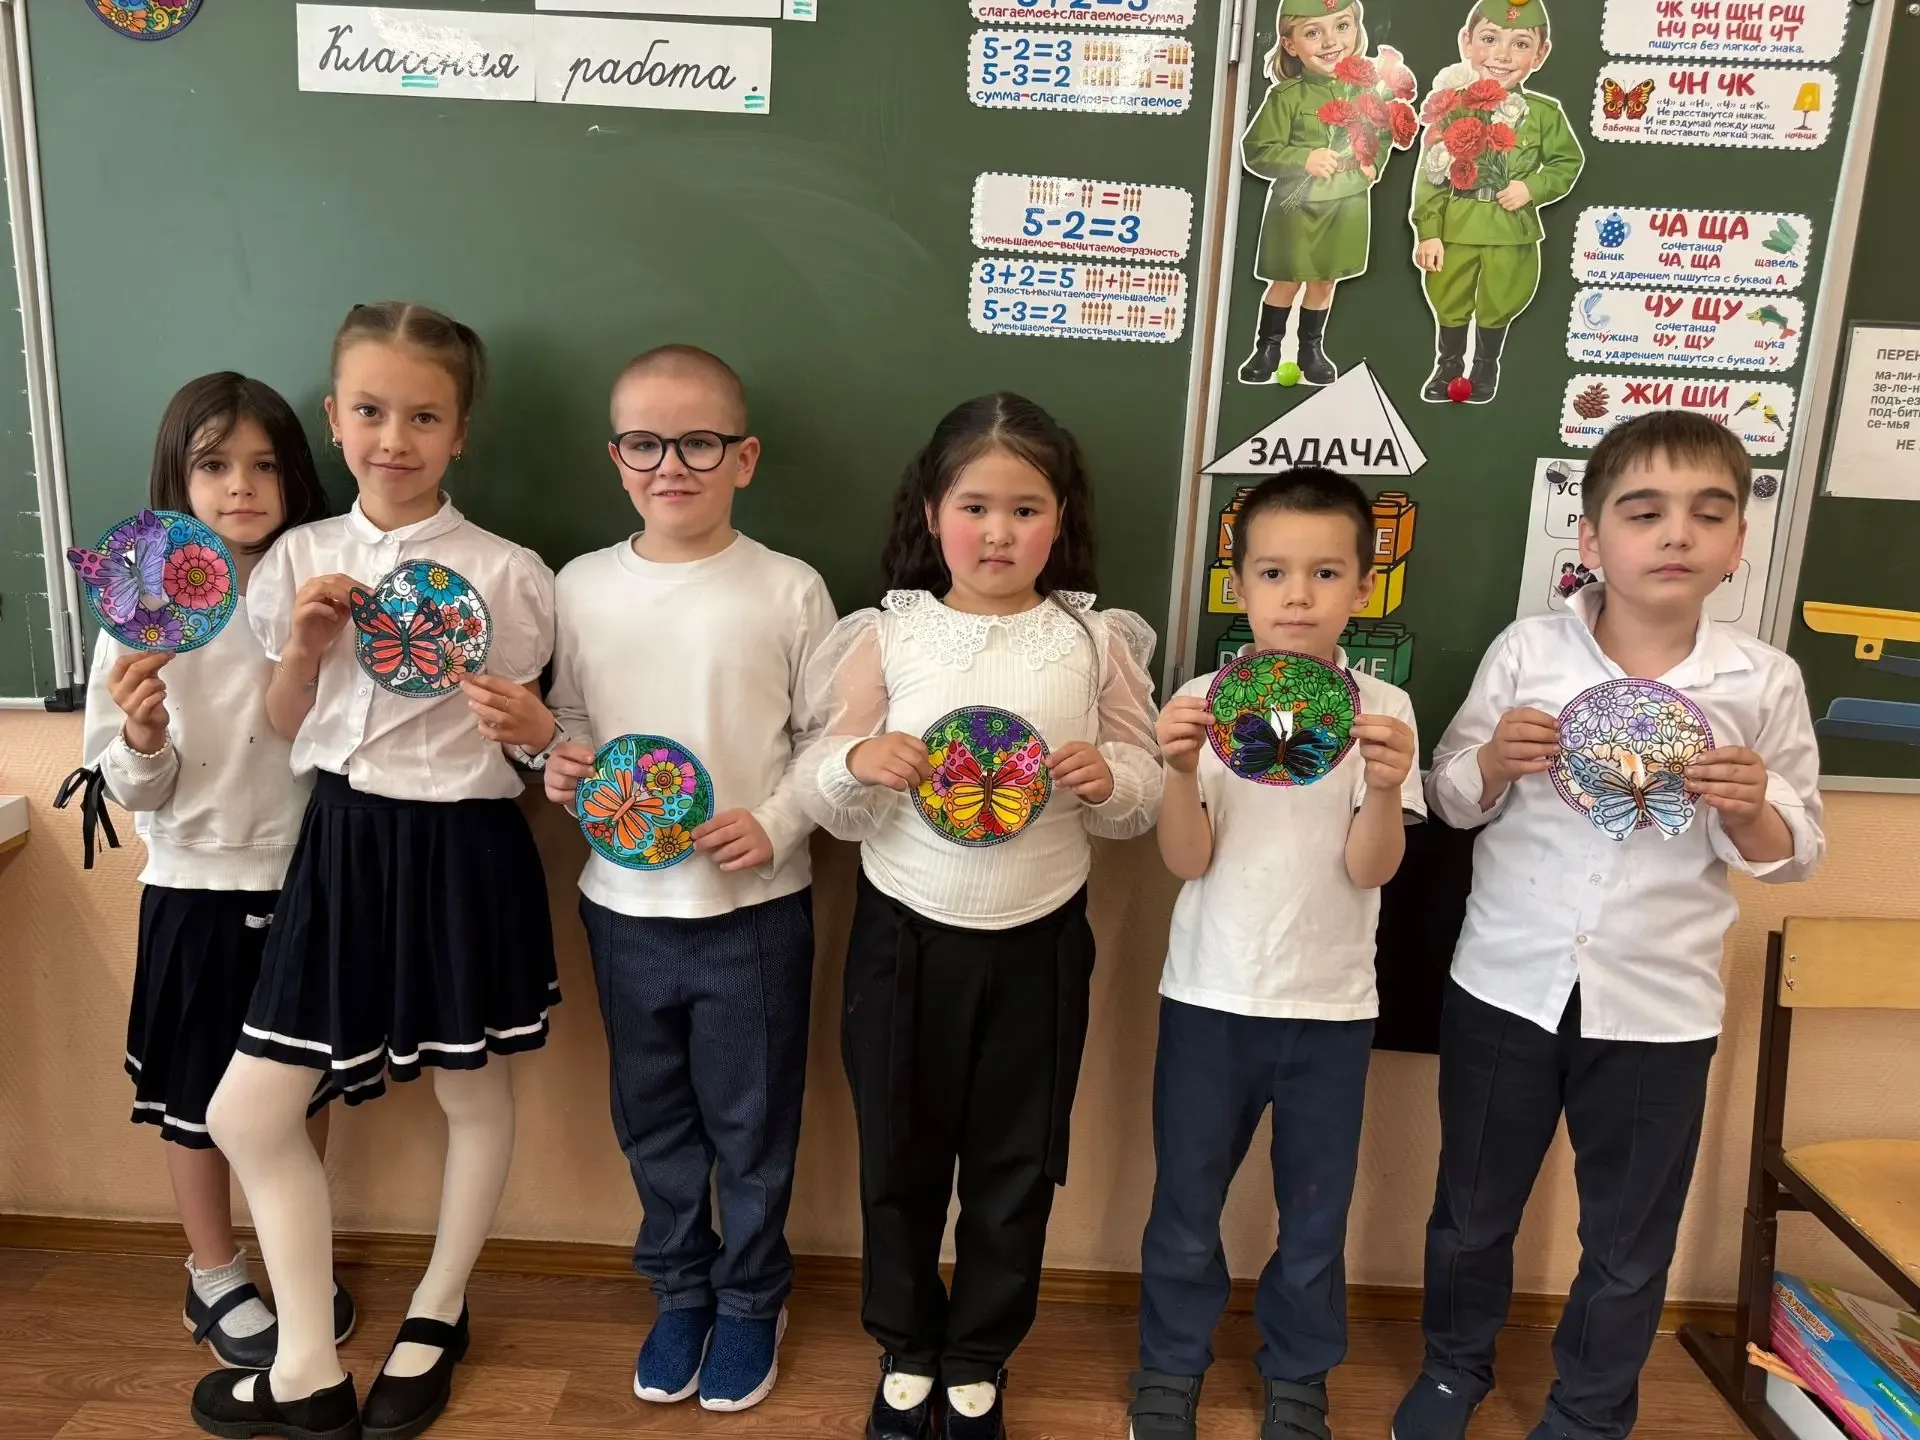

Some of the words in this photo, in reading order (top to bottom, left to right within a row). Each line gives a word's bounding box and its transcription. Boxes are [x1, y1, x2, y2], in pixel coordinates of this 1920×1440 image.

[1656, 1, 1684, 18] ЧК
[1690, 1, 1720, 19] ЧН
[1725, 3, 1764, 22] ЩН
[1768, 5, 1805, 25] РЩ
[1657, 20, 1686, 39] НЧ
[1691, 22, 1720, 40] РЧ
[1725, 22, 1763, 43] НЩ
[1770, 24, 1799, 42] ЧТ
[318, 25, 518, 81] Классная
[982, 37, 1073, 62] 5-2=3
[1648, 40, 1697, 51] пишутся
[1700, 39, 1719, 50] без
[1723, 43, 1767, 52] мягкого
[1770, 44, 1805, 53] знака.
[981, 63, 1071, 88] 5-3=2
[1668, 71, 1708, 95] ЧН
[1717, 72, 1755, 97] ЧК
[1657, 107, 1671, 117] Не
[1672, 110, 1733, 119] расстанутся
[1602, 123, 1640, 133] бабочка
[1645, 116, 1653, 125] И
[1656, 118, 1667, 126] не
[1714, 121, 1748, 130] между
[1750, 122, 1776, 131] ними
[1644, 126, 1658, 135] Ты
[1661, 128, 1710, 137] поставить
[1712, 130, 1748, 139] мягкий
[1784, 131, 1818, 140] ночник
[1022, 207, 1141, 244] 5-2=3
[1649, 213, 1688, 238] ЧА
[1698, 214, 1750, 243] ЩА
[1661, 242, 1723, 252] сочетания
[1658, 253, 1685, 270] ЧА,
[1690, 254, 1721, 270] ЩА
[979, 263, 1076, 289] 3+2=5
[1587, 270, 1607, 280] под
[1610, 271, 1670, 282] ударением
[1673, 273, 1720, 284] пишутся
[1733, 273, 1772, 285] буквой
[1775, 274, 1788, 285] А.
[982, 299, 1067, 325] 5-3=2
[1644, 294, 1684, 318] ЧУ
[1691, 296, 1743, 324] ЩУ
[1655, 323, 1716, 333] сочетания
[1653, 333, 1679, 350] ЧУ,
[1684, 334, 1714, 350] ЩУ
[1582, 349, 1601, 359] под
[1604, 350, 1664, 361] ударением
[1667, 352, 1714, 364] пишутся
[1727, 354, 1765, 366] буквой
[1768, 355, 1780, 366] У.
[1621, 382, 1674, 406] ЖИ
[1681, 385, 1730, 409] ШИ
[1867, 419, 1910, 430] се-мья
[1249, 437, 1398, 468] ЗАДАЧА
[1896, 439, 1916, 450] НЕ
